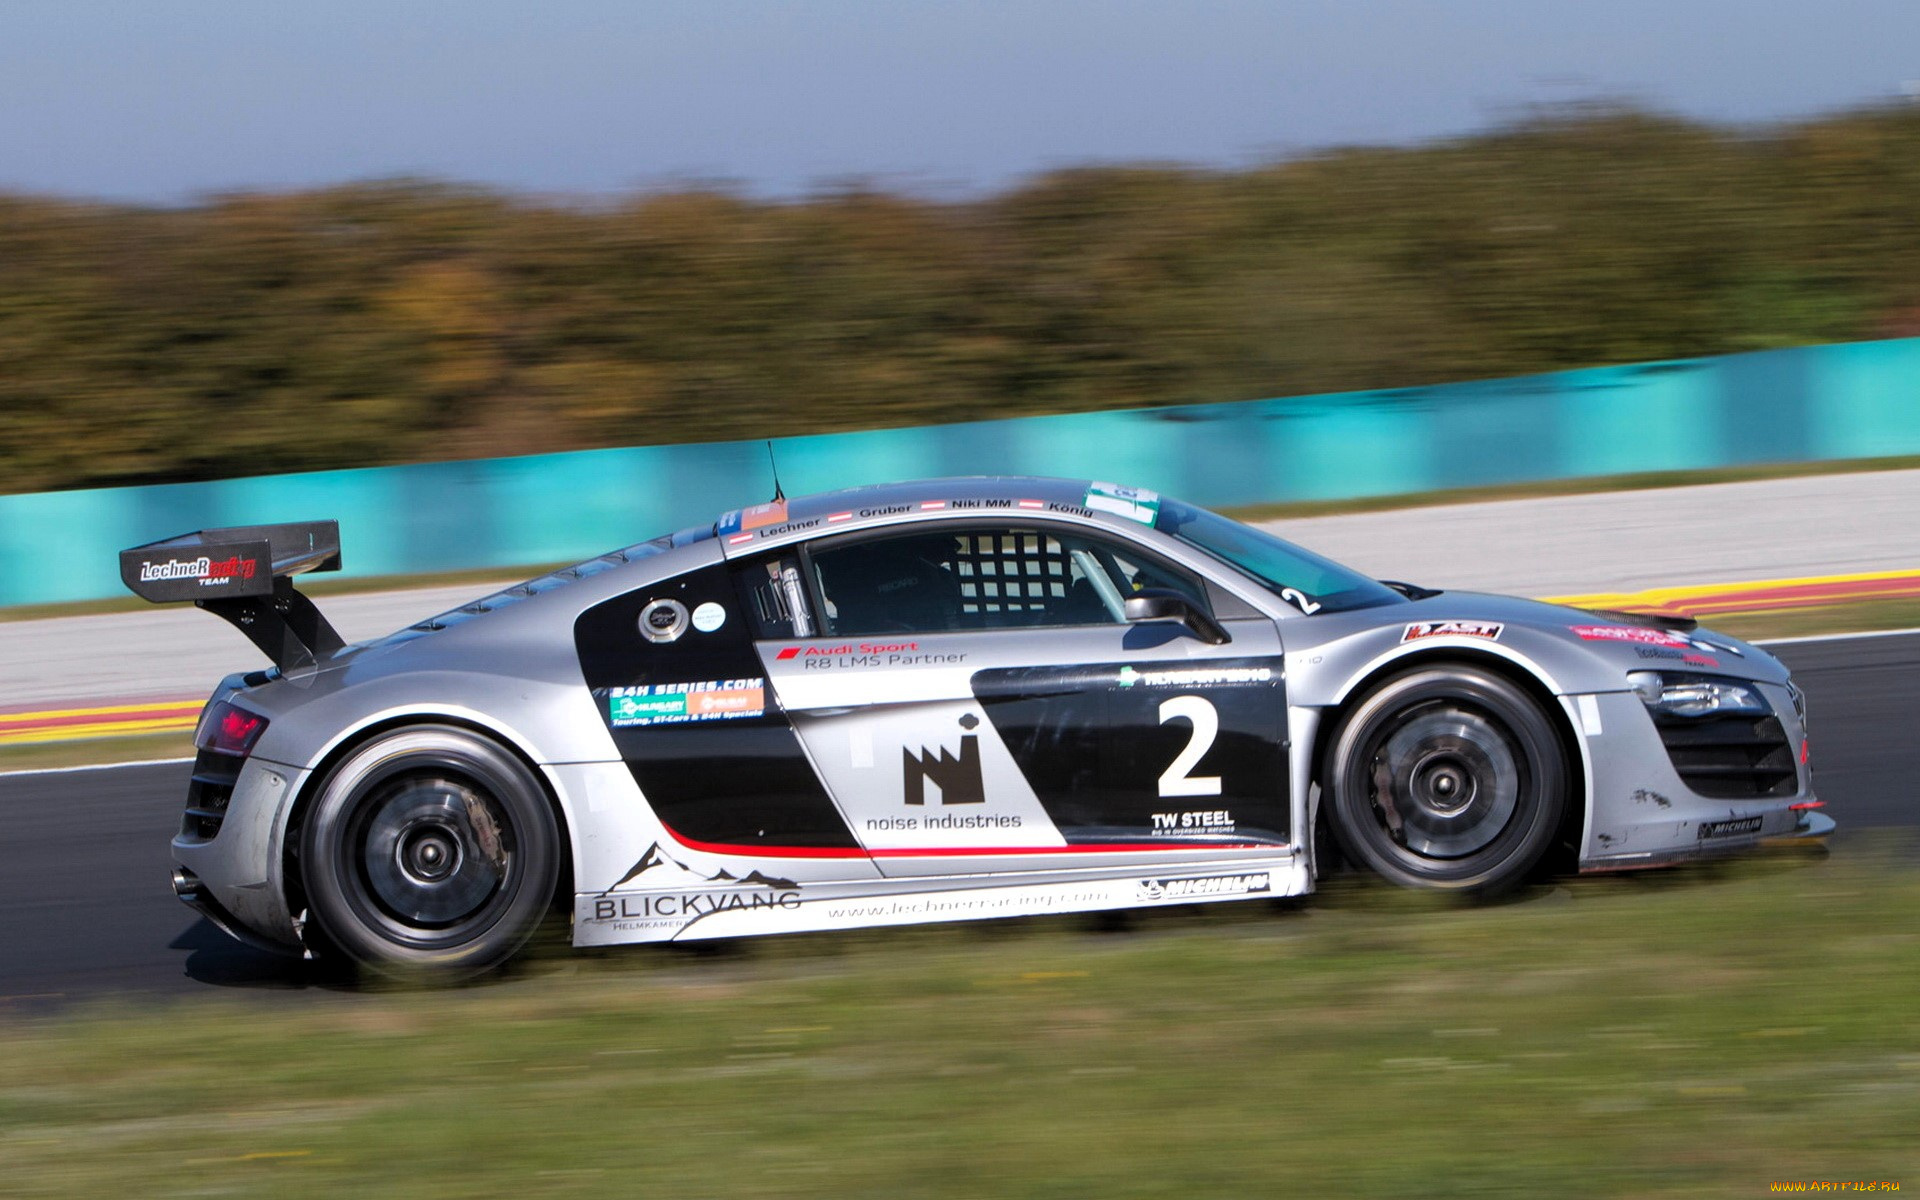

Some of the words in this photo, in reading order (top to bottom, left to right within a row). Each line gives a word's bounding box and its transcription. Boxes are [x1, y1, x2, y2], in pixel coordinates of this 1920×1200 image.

[859, 504, 913, 518] Gruber
[952, 499, 980, 509] Niki
[985, 499, 1012, 508] MM
[1048, 501, 1094, 519] König
[760, 518, 820, 538] Lechner
[199, 577, 229, 586] TEAM
[1281, 588, 1321, 615] 2
[804, 644, 852, 656] Audi
[859, 642, 918, 655] Sport
[805, 657, 831, 669] R8
[839, 655, 880, 668] LMS
[889, 652, 968, 666] Partner
[612, 686, 649, 698] 24H
[655, 678, 762, 695] SERIES.COM
[1158, 695, 1222, 797] 2
[867, 815, 917, 830] noise
[924, 813, 1022, 829] industries
[1151, 812, 1178, 829] TW
[1181, 810, 1235, 828] STEEL
[1714, 819, 1761, 833] MICHELIN
[595, 891, 801, 920] BLICKVANG
